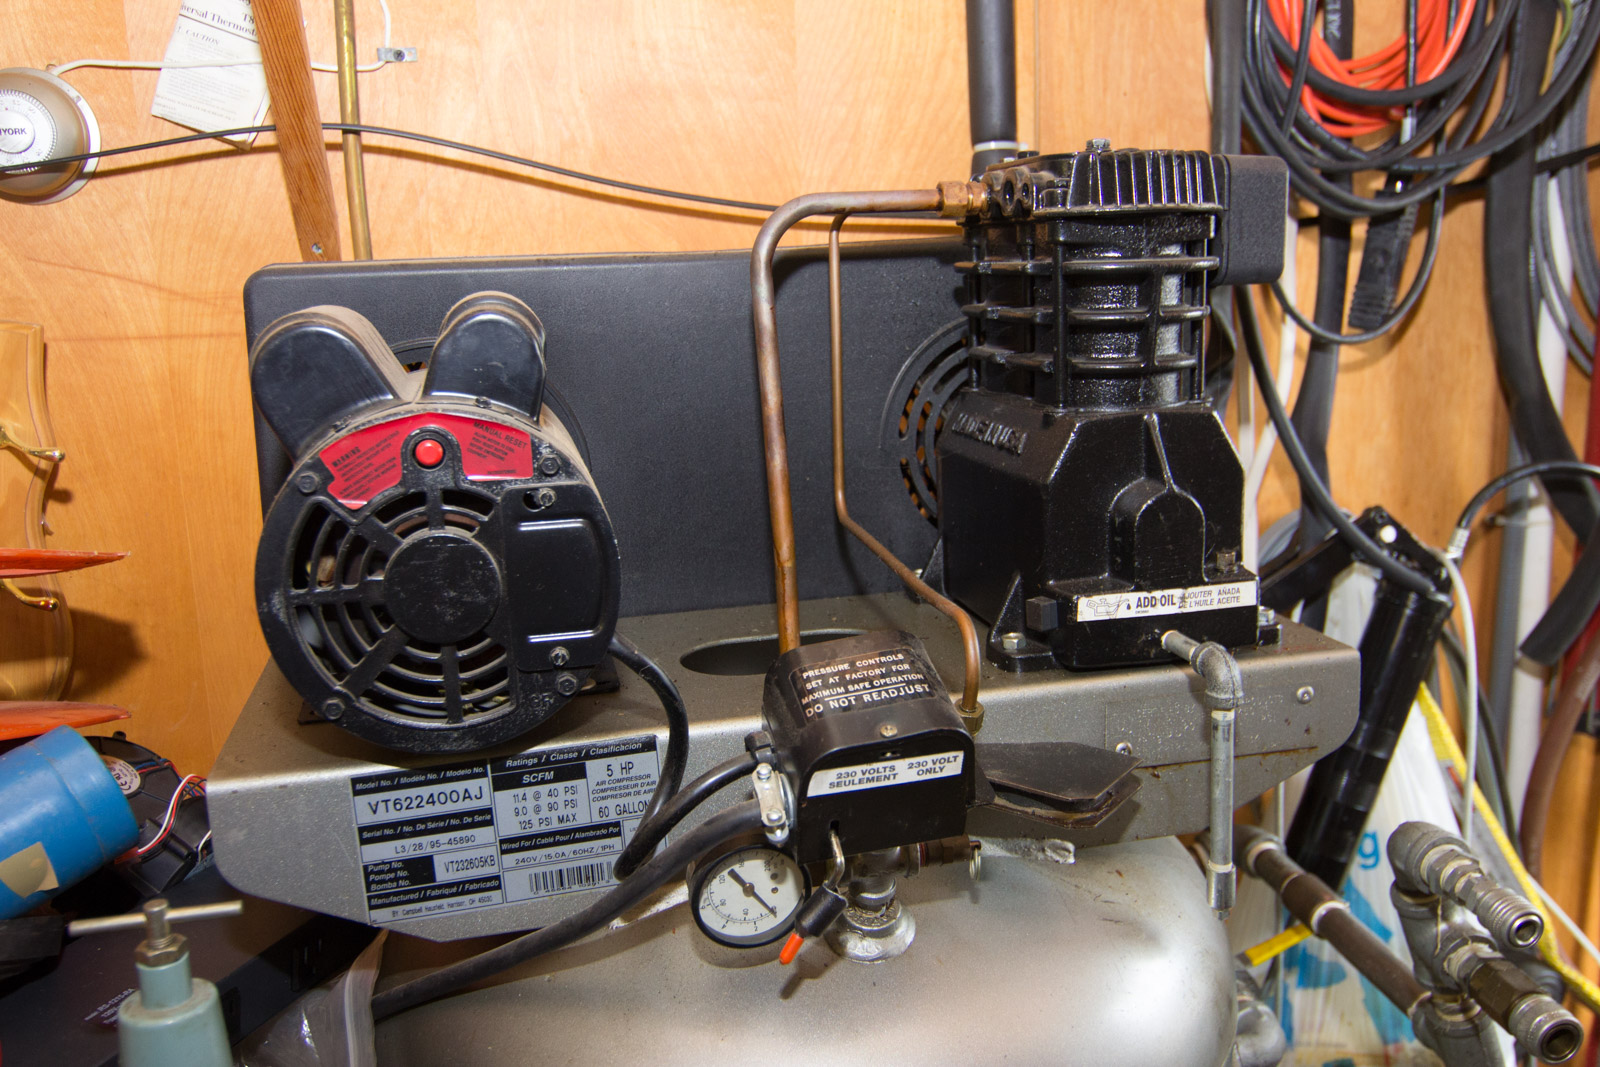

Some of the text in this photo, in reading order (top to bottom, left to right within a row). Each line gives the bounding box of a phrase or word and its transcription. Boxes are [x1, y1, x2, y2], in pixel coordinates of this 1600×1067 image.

[473, 421, 503, 440] MANUAL
[503, 433, 528, 449] RESET
[331, 446, 361, 467] WARNING
[1136, 596, 1156, 609] ADD
[1160, 594, 1176, 607] OIL
[1218, 587, 1240, 596] AÑADA
[1189, 598, 1214, 608] L'HUILE
[1217, 596, 1240, 605] ACEITE
[803, 653, 904, 679] PRESSURE CONTROLS
[806, 663, 910, 690] SET AT FACTORY FOR
[802, 674, 924, 705] MAXIMUM SAFE OPERATION
[806, 684, 930, 717] DO NOT READJUST
[506, 757, 538, 768] Ratings
[550, 751, 578, 761] Classe
[908, 755, 959, 770] 230 VOLT
[522, 771, 554, 783] SCFM
[607, 761, 634, 777] 5 HP
[836, 765, 896, 780] 230 VOLTS
[917, 766, 946, 776] ONLY
[356, 780, 378, 790] Model
[446, 768, 471, 777] Modelo
[608, 774, 650, 785] COMPRESSOR
[829, 773, 899, 789] SEULEMENT
[513, 785, 578, 803] 11.4 @ 40 PSI
[592, 783, 639, 795] COMPRESSEUR
[592, 791, 632, 802] COMPRESOR
[368, 786, 483, 815] VT622400AJ
[514, 799, 578, 817] 9.0 @ 90 PSI
[599, 806, 609, 818] 60
[362, 828, 382, 838] Serial
[474, 813, 491, 822] Serie
[519, 813, 577, 830] 125 PSI MAX
[502, 841, 519, 850] Wired
[575, 829, 607, 839] Alambrado
[368, 864, 390, 872] Pump
[444, 855, 495, 873] VT232605KB
[369, 873, 395, 882] Pompe
[371, 882, 396, 891] Bomba
[371, 892, 419, 905] Manufactured
[465, 880, 499, 890] Fabricado
